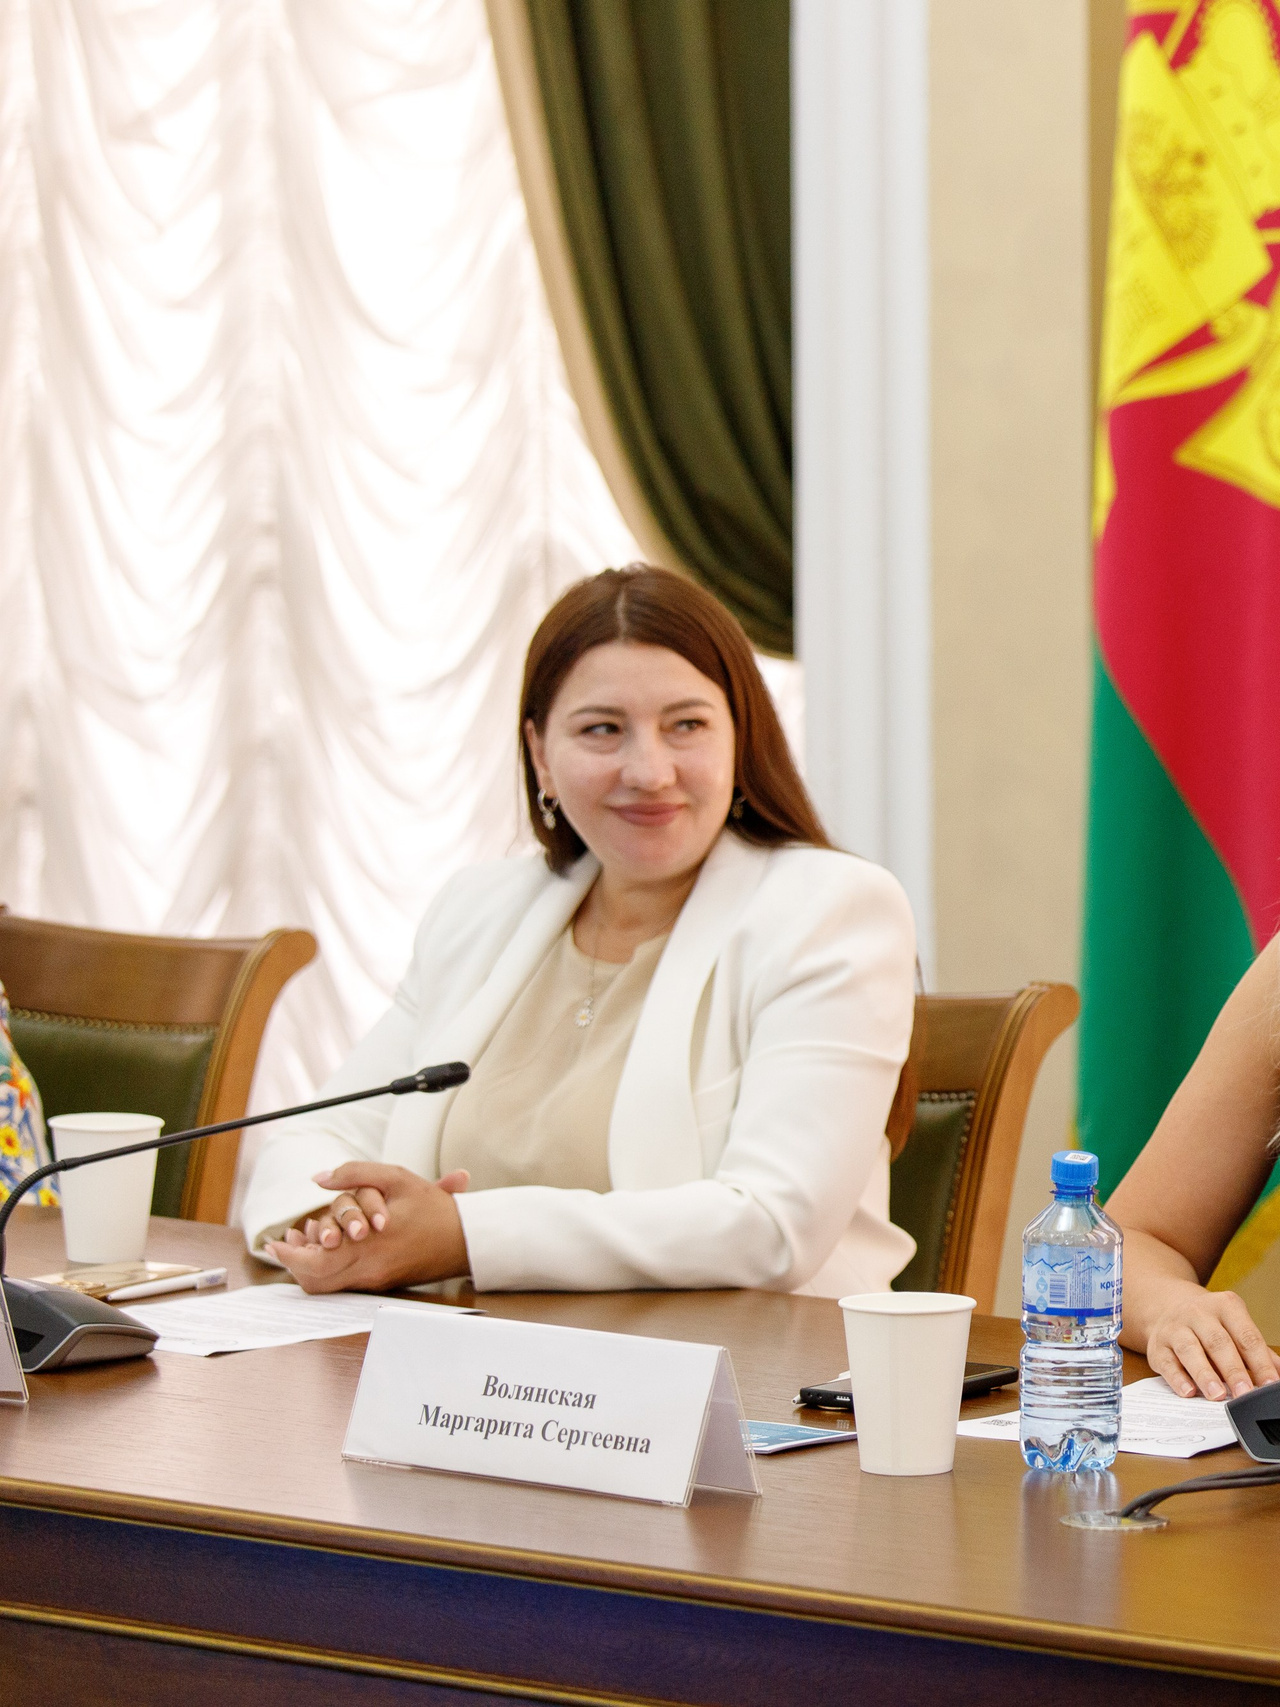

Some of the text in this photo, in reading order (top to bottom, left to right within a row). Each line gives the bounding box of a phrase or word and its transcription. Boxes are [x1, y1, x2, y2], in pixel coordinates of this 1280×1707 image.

[482, 1374, 597, 1410] Волянская
[418, 1403, 651, 1454] Маргарита Сергеевна
